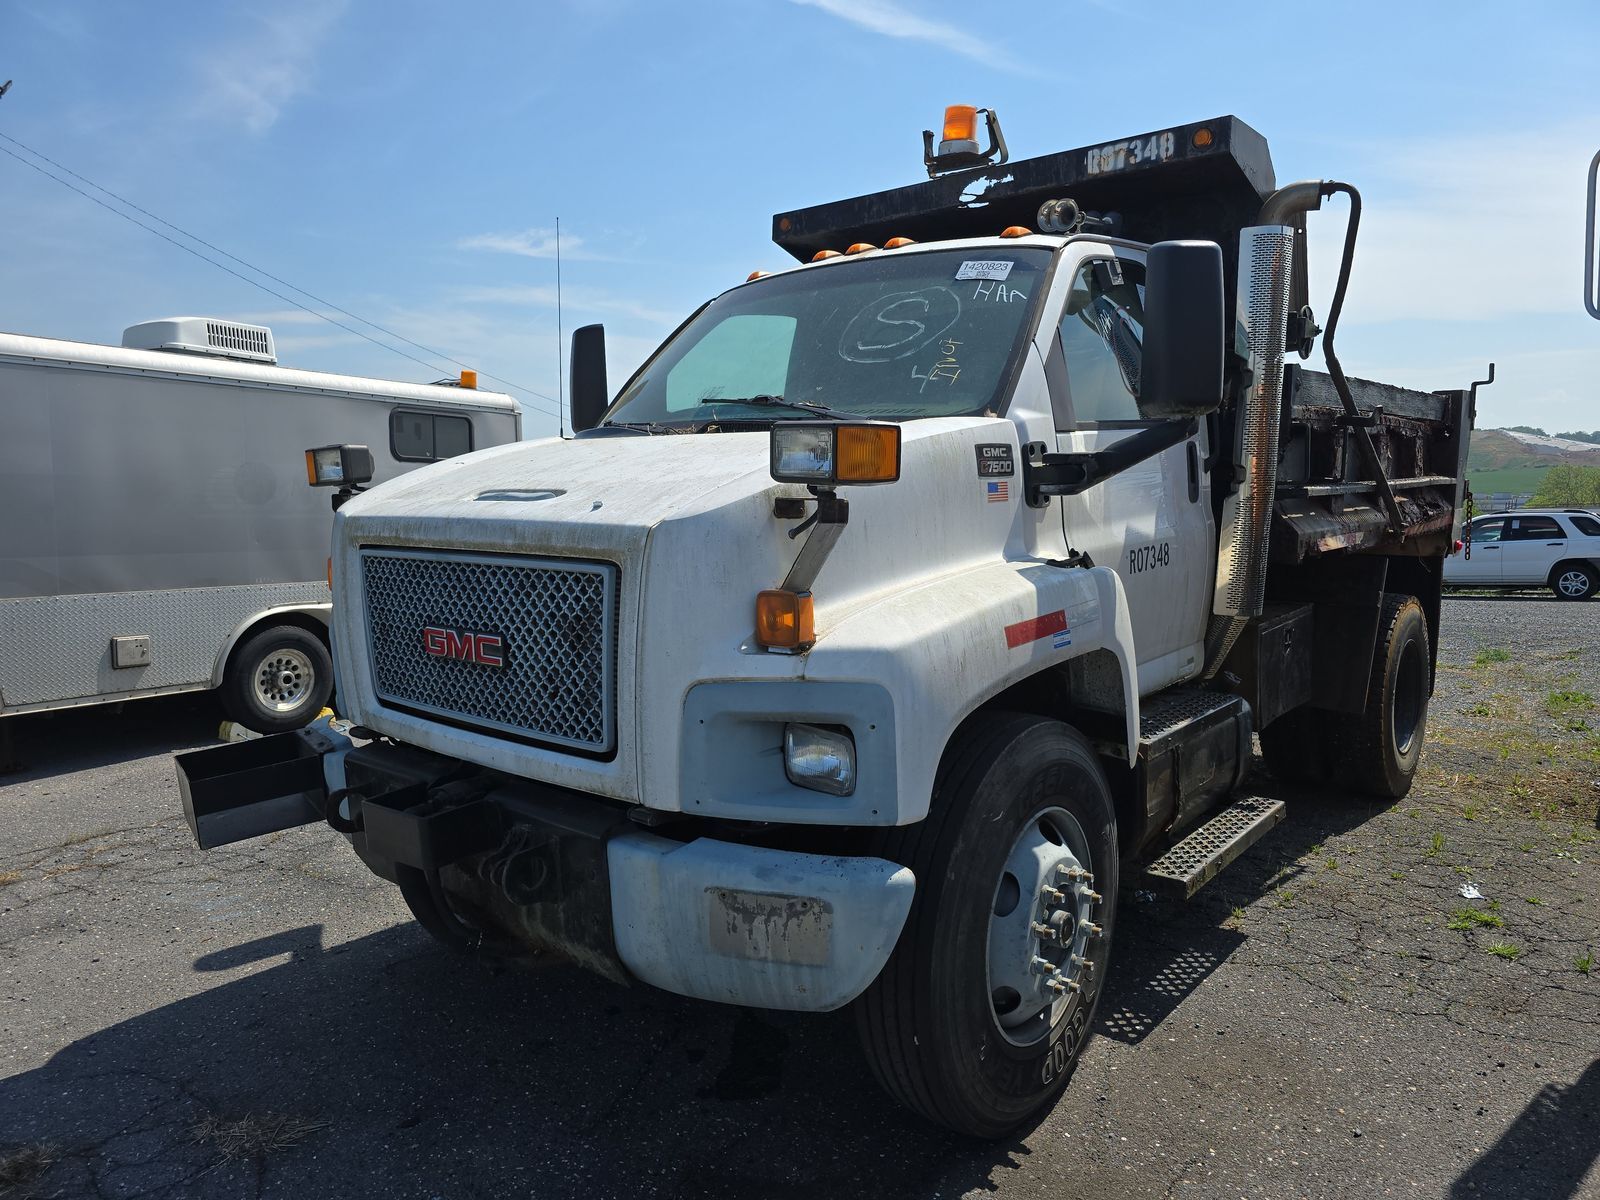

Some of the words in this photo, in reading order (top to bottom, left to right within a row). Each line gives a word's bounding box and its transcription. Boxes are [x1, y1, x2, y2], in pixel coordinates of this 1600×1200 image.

[1087, 132, 1175, 175] R07348
[963, 262, 1009, 272] 1420823
[982, 447, 1008, 458] GMC
[980, 460, 1012, 474] C7500
[1129, 542, 1170, 574] R07348
[423, 626, 503, 667] GMC
